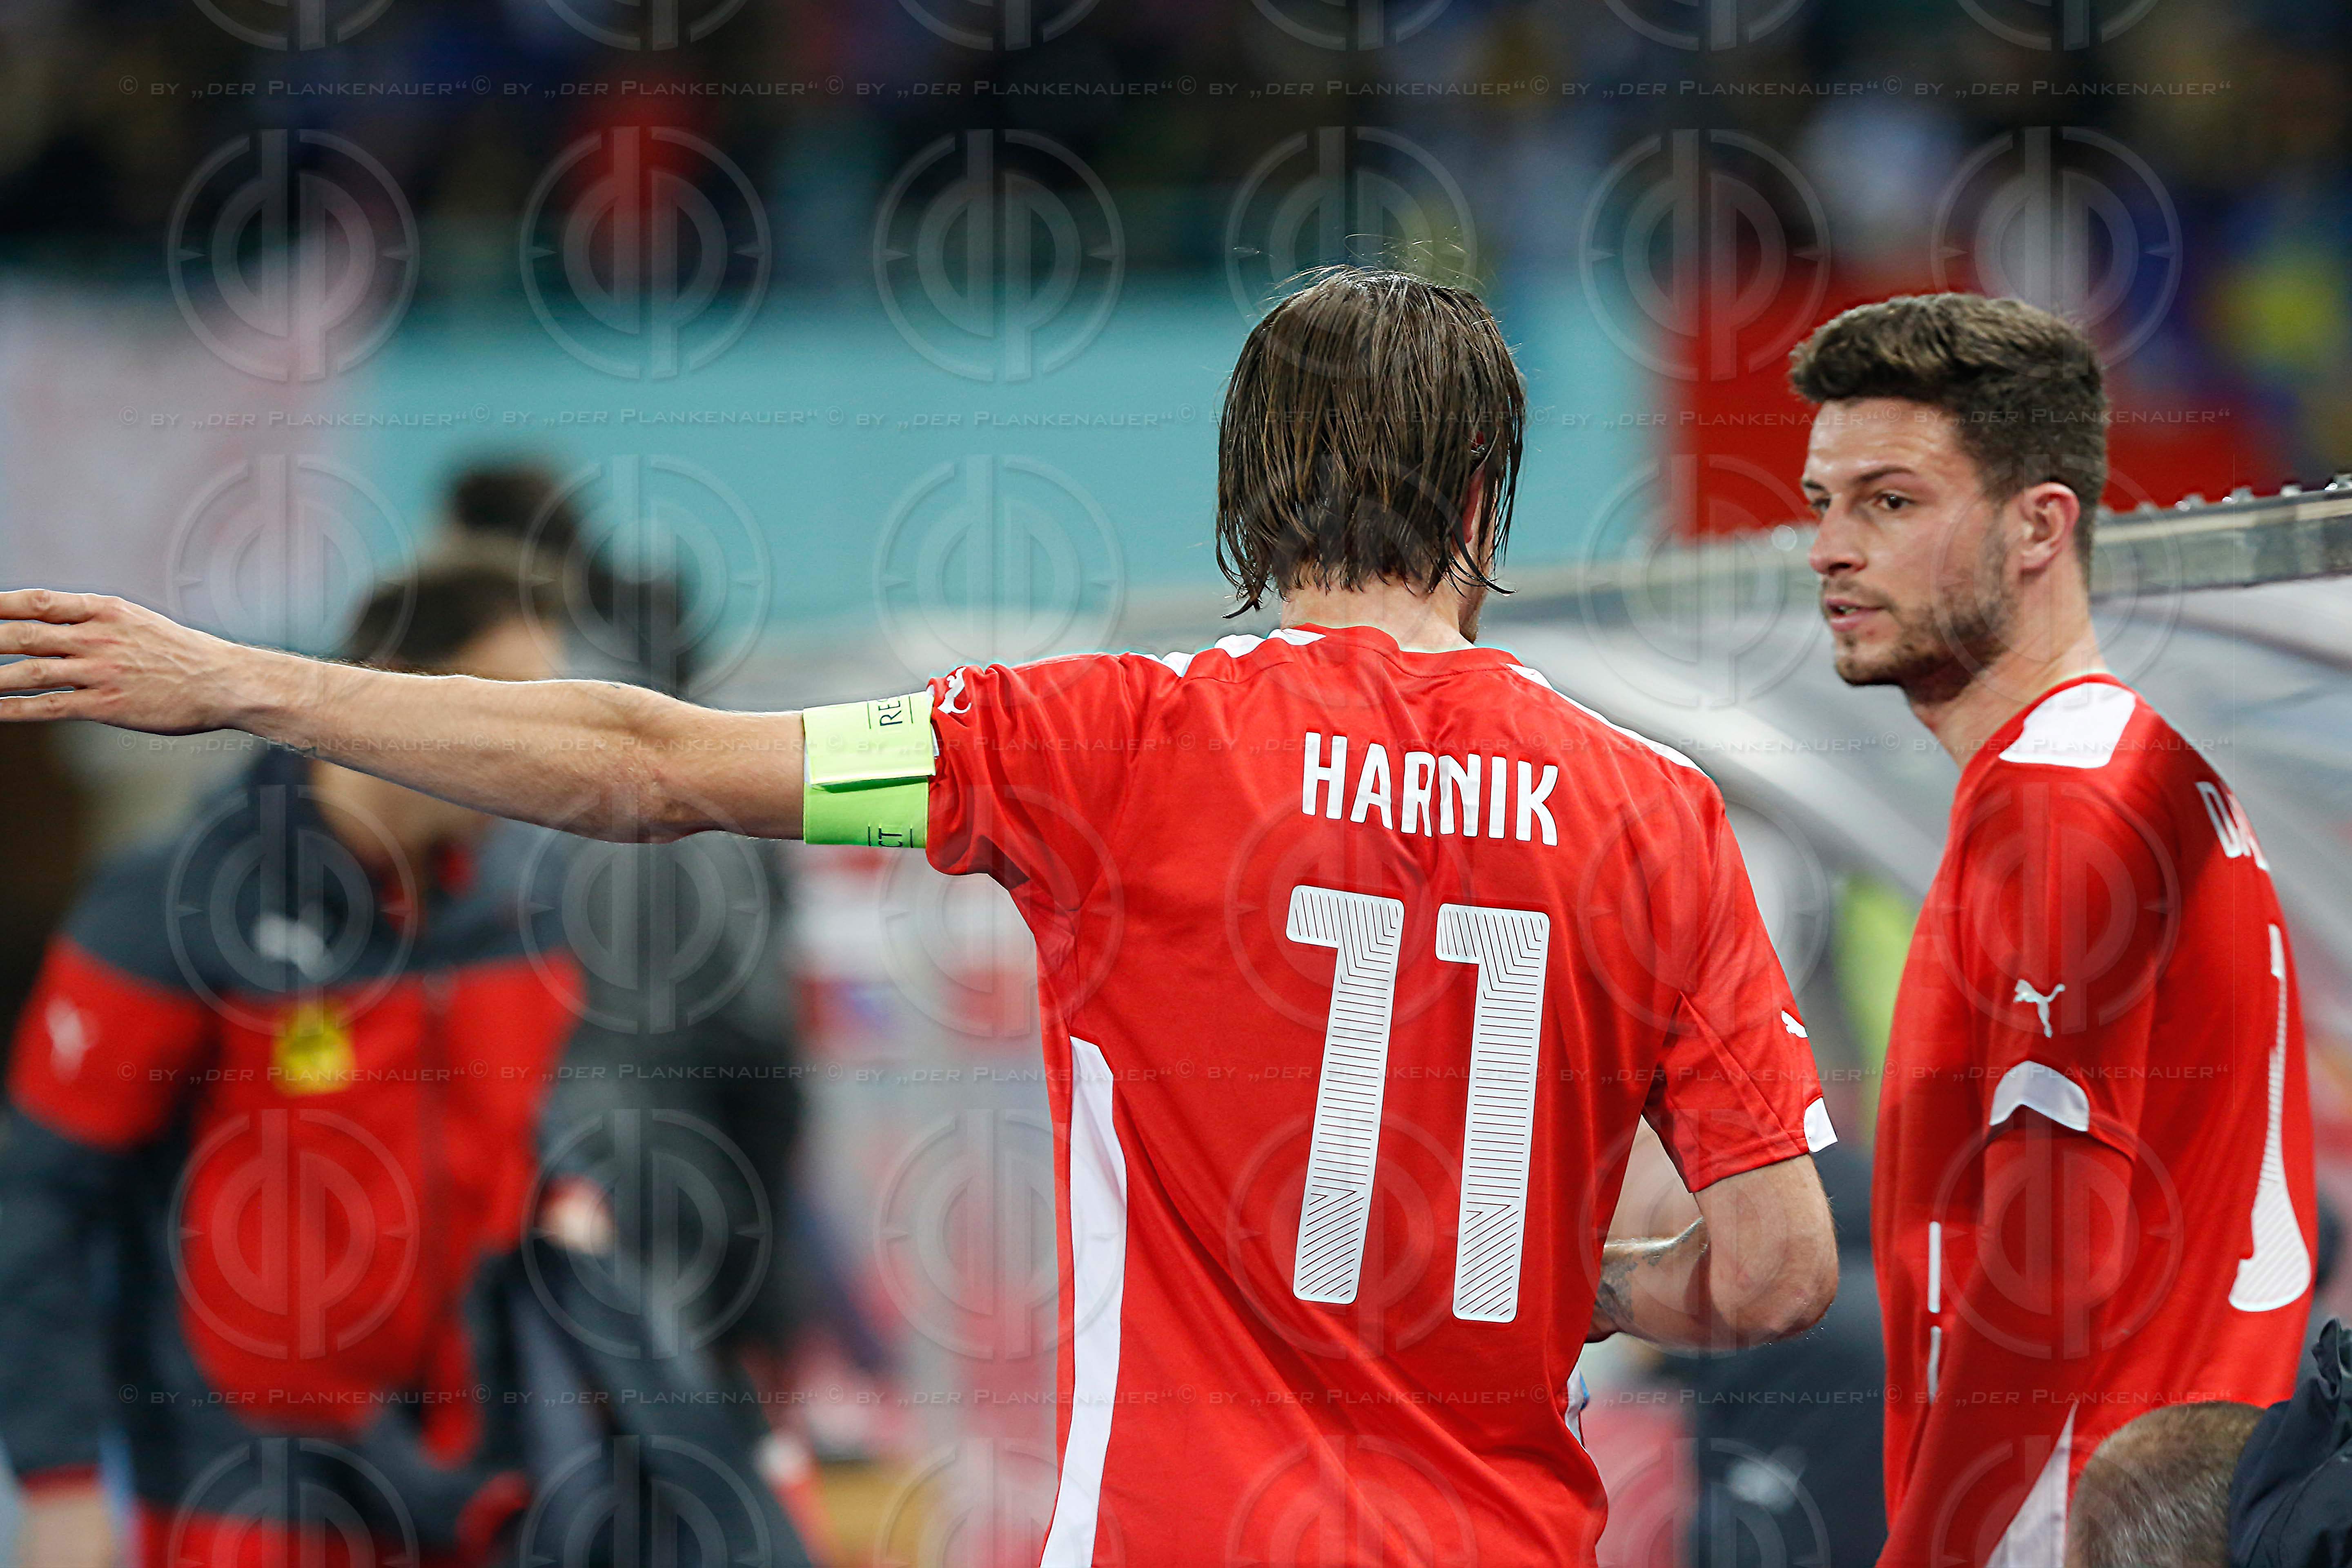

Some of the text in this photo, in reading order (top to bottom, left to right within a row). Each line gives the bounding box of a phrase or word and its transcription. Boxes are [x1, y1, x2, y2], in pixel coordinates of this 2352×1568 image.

[877, 699, 903, 726] RE
[1301, 731, 1558, 846] HARNIK
[1286, 884, 1550, 1323] 11
